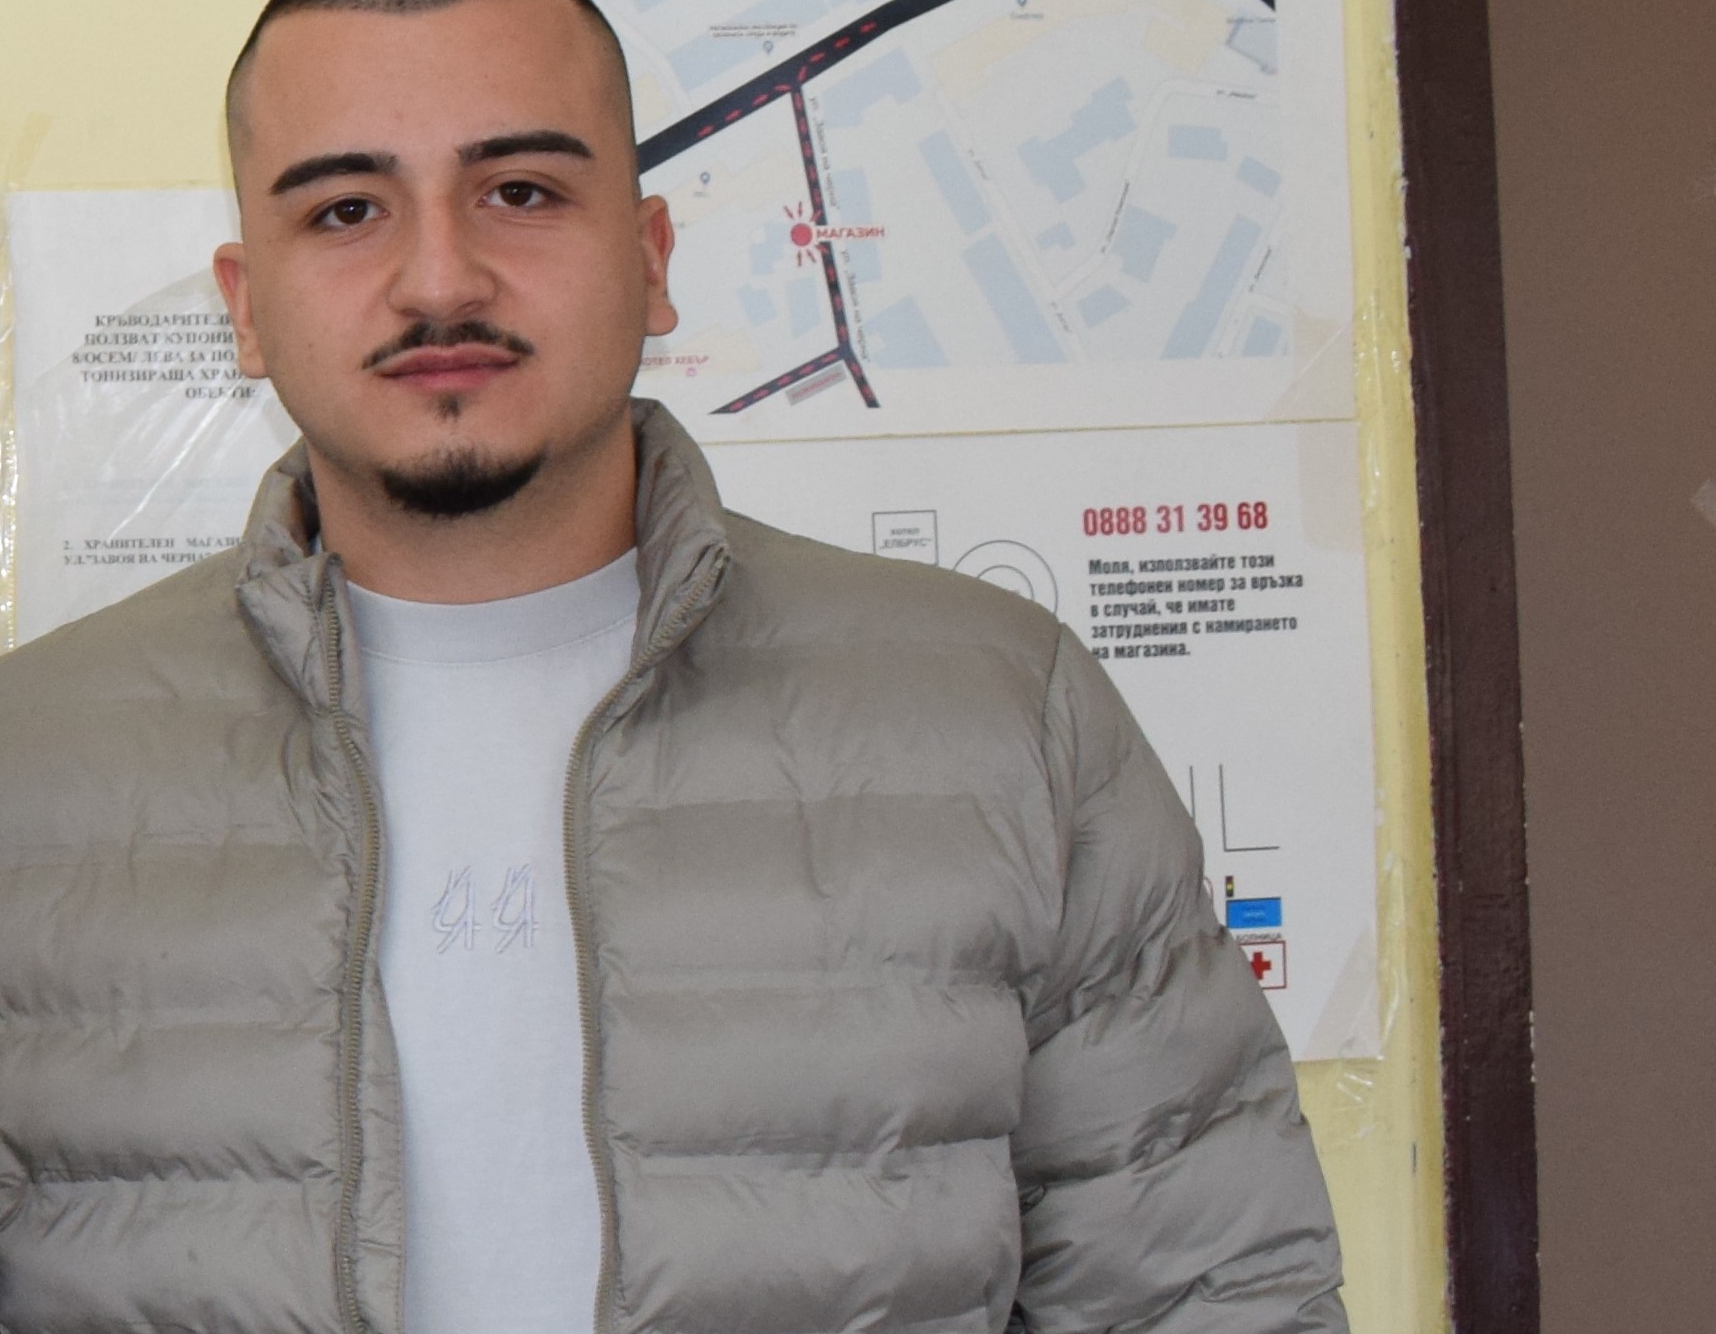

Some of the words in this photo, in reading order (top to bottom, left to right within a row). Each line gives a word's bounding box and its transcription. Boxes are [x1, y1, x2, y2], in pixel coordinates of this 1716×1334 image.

[817, 226, 884, 239] МАГАЗИН
[1083, 506, 1147, 536] 0888
[1156, 504, 1184, 534] 31
[1198, 502, 1228, 532] 39
[1236, 501, 1268, 530] 68
[84, 537, 175, 550] ХРАНИТЕЛЕН
[1089, 558, 1134, 576] Моля,
[1139, 553, 1236, 573] използвайте
[1241, 554, 1275, 569] този
[1091, 578, 1173, 597] телефонен
[1178, 578, 1225, 595] номер
[1230, 577, 1246, 591] за
[1251, 574, 1303, 592] връзка
[1090, 604, 1099, 618] в
[1103, 599, 1161, 618] случай,
[1166, 600, 1183, 614] че
[1187, 597, 1235, 613] имате
[1091, 620, 1188, 640] затруднения
[1192, 620, 1201, 635] с
[1205, 616, 1298, 635] намирането
[1092, 647, 1110, 660] на
[1113, 642, 1191, 659] магазина.
